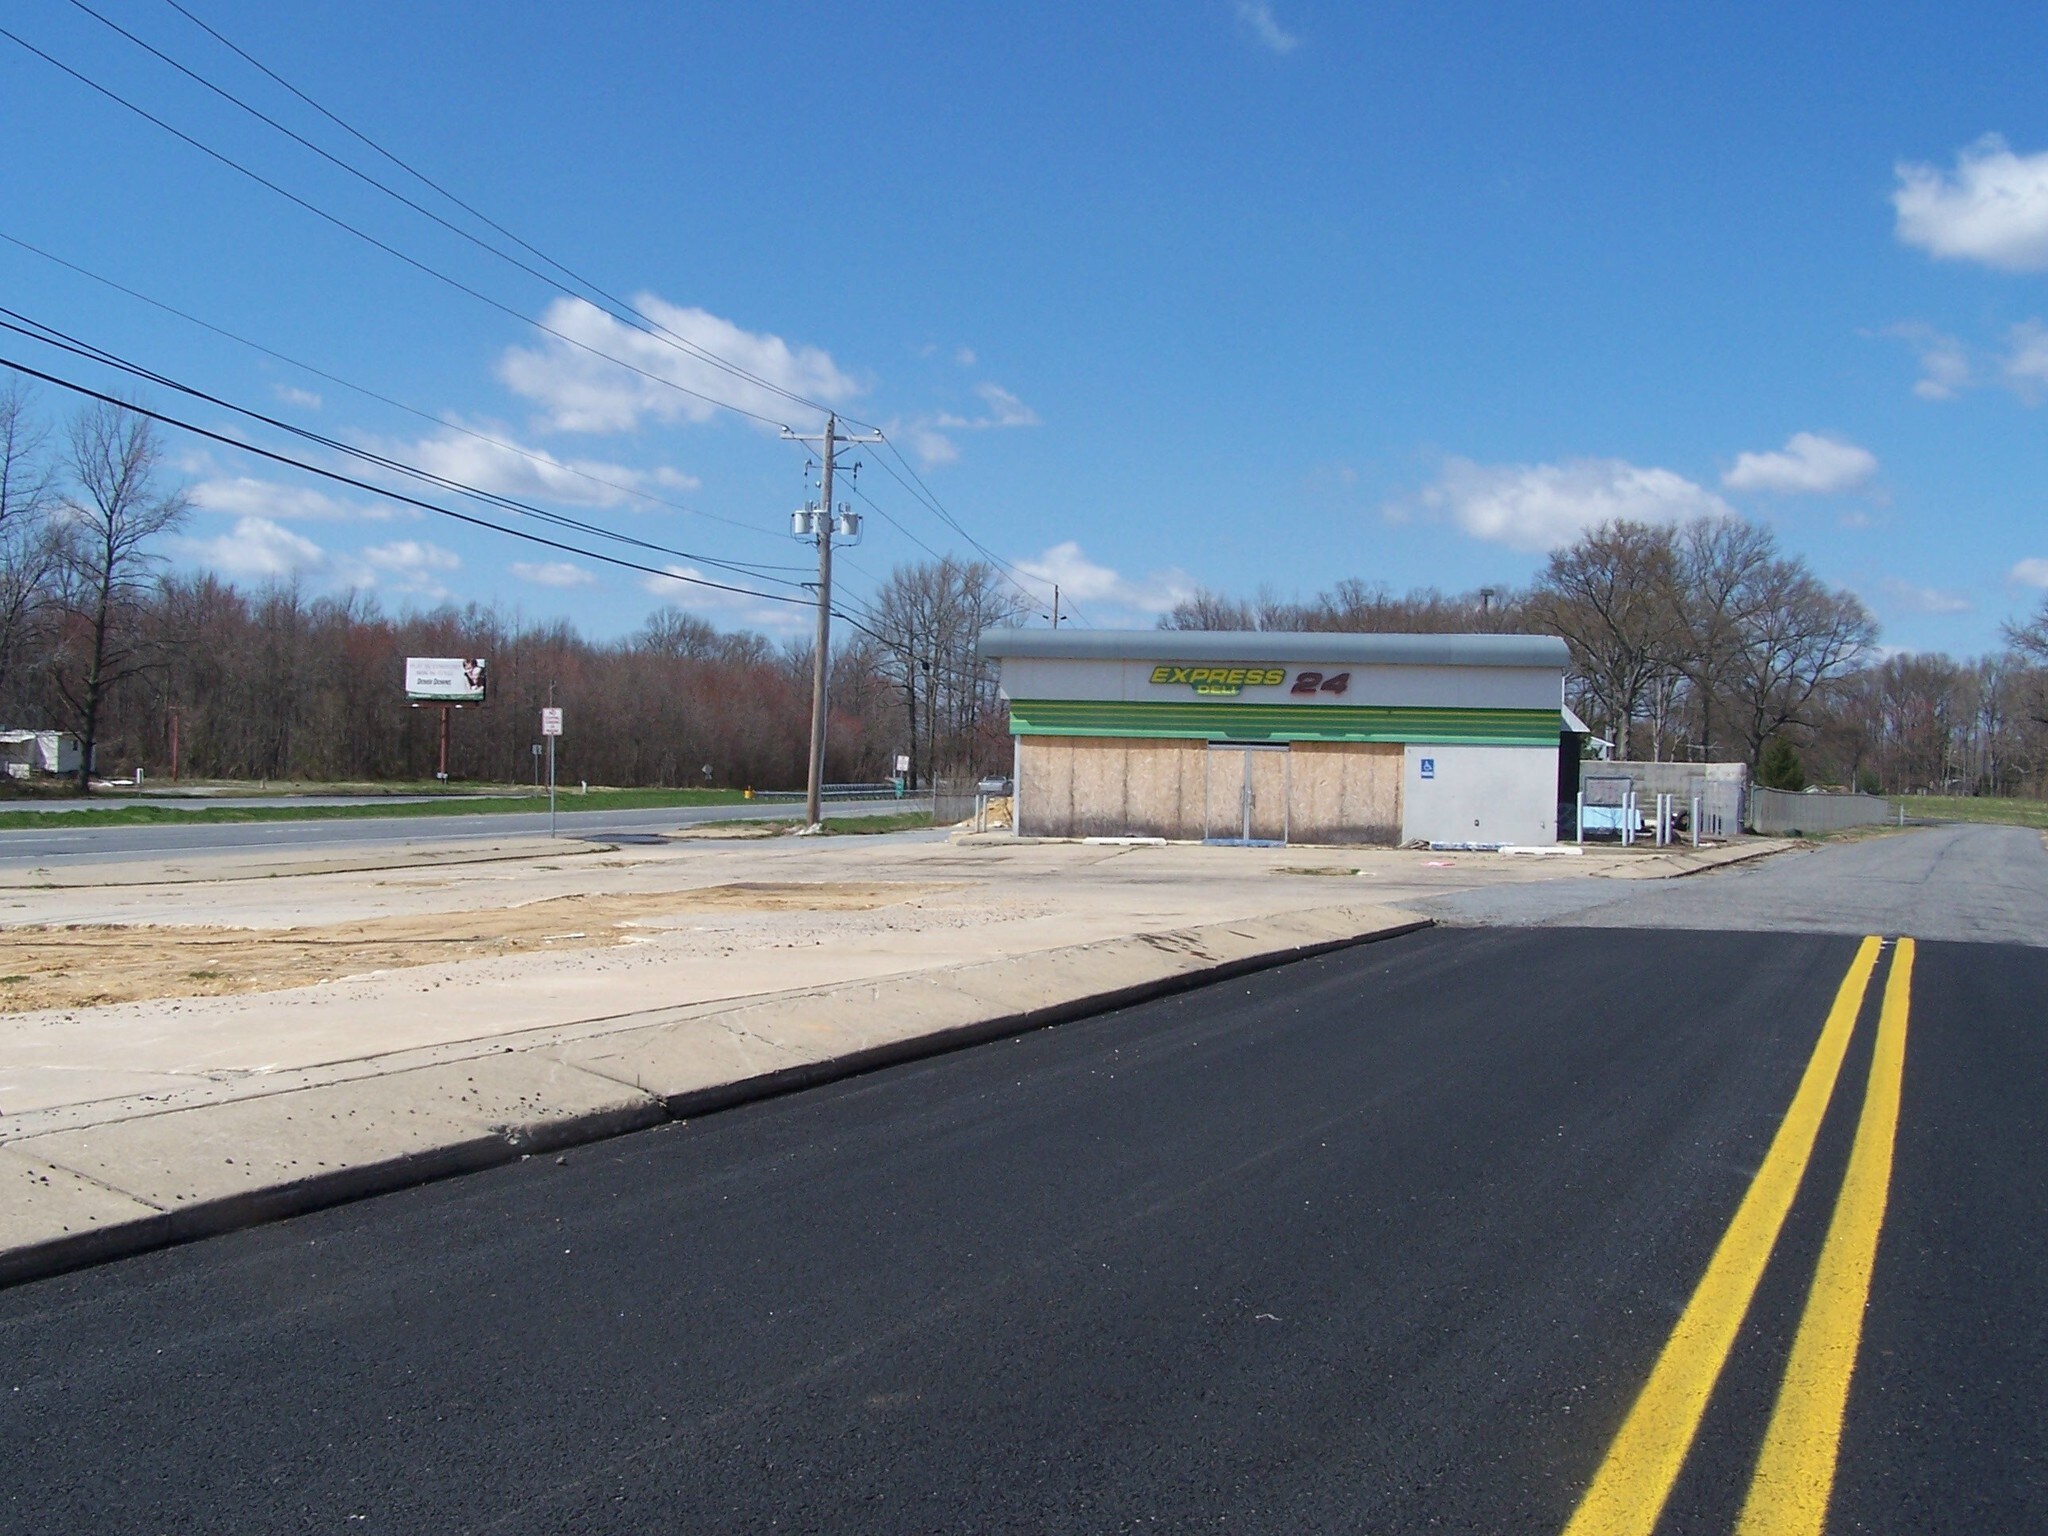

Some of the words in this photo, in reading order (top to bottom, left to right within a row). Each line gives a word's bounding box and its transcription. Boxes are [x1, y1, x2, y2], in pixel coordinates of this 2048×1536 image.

[1150, 667, 1286, 685] EXPRESS
[1291, 671, 1350, 695] 24
[1197, 684, 1239, 694] DELI
